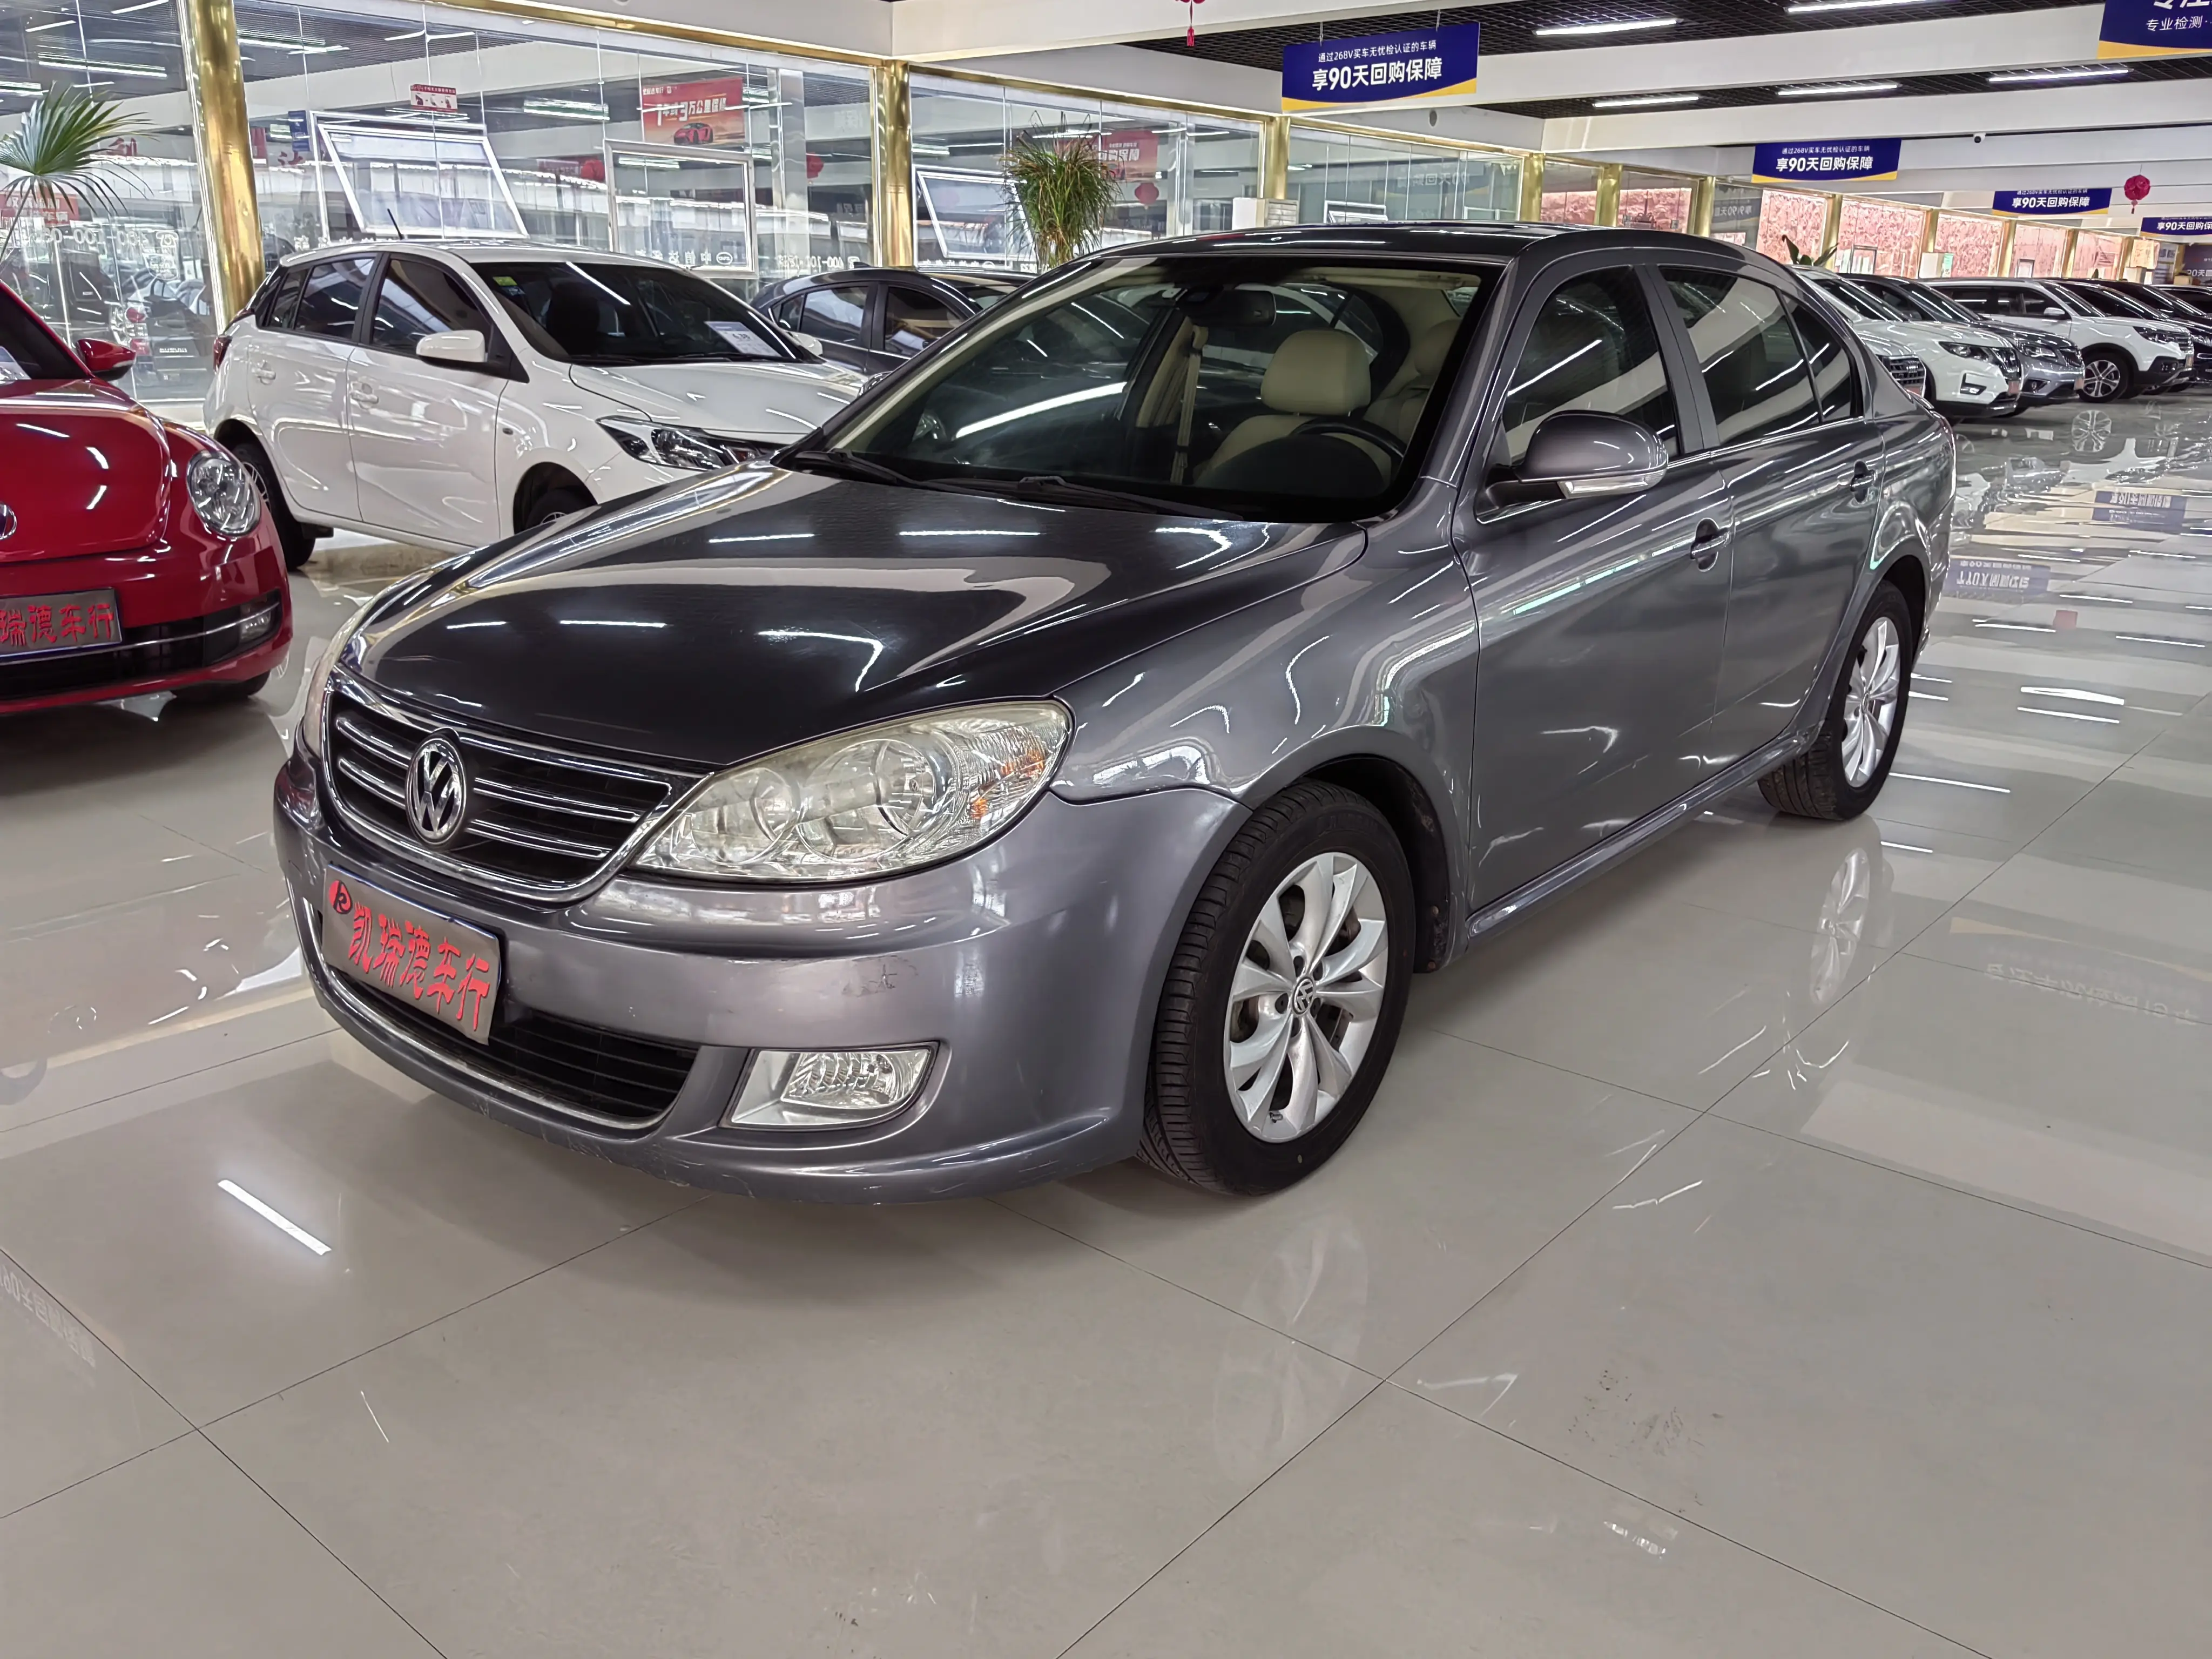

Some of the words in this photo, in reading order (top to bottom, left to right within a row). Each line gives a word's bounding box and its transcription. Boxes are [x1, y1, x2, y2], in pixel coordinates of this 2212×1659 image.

[1318, 40, 1437, 63] 通过268V买车无忧检认证的车辆
[1312, 57, 1442, 91] 享90天回购保障
[1782, 145, 1870, 154] 通过268V买车无忧检认证的车辆
[1776, 156, 1873, 172] 享90天回购保障
[2012, 197, 2090, 208] 享90天回购保障
